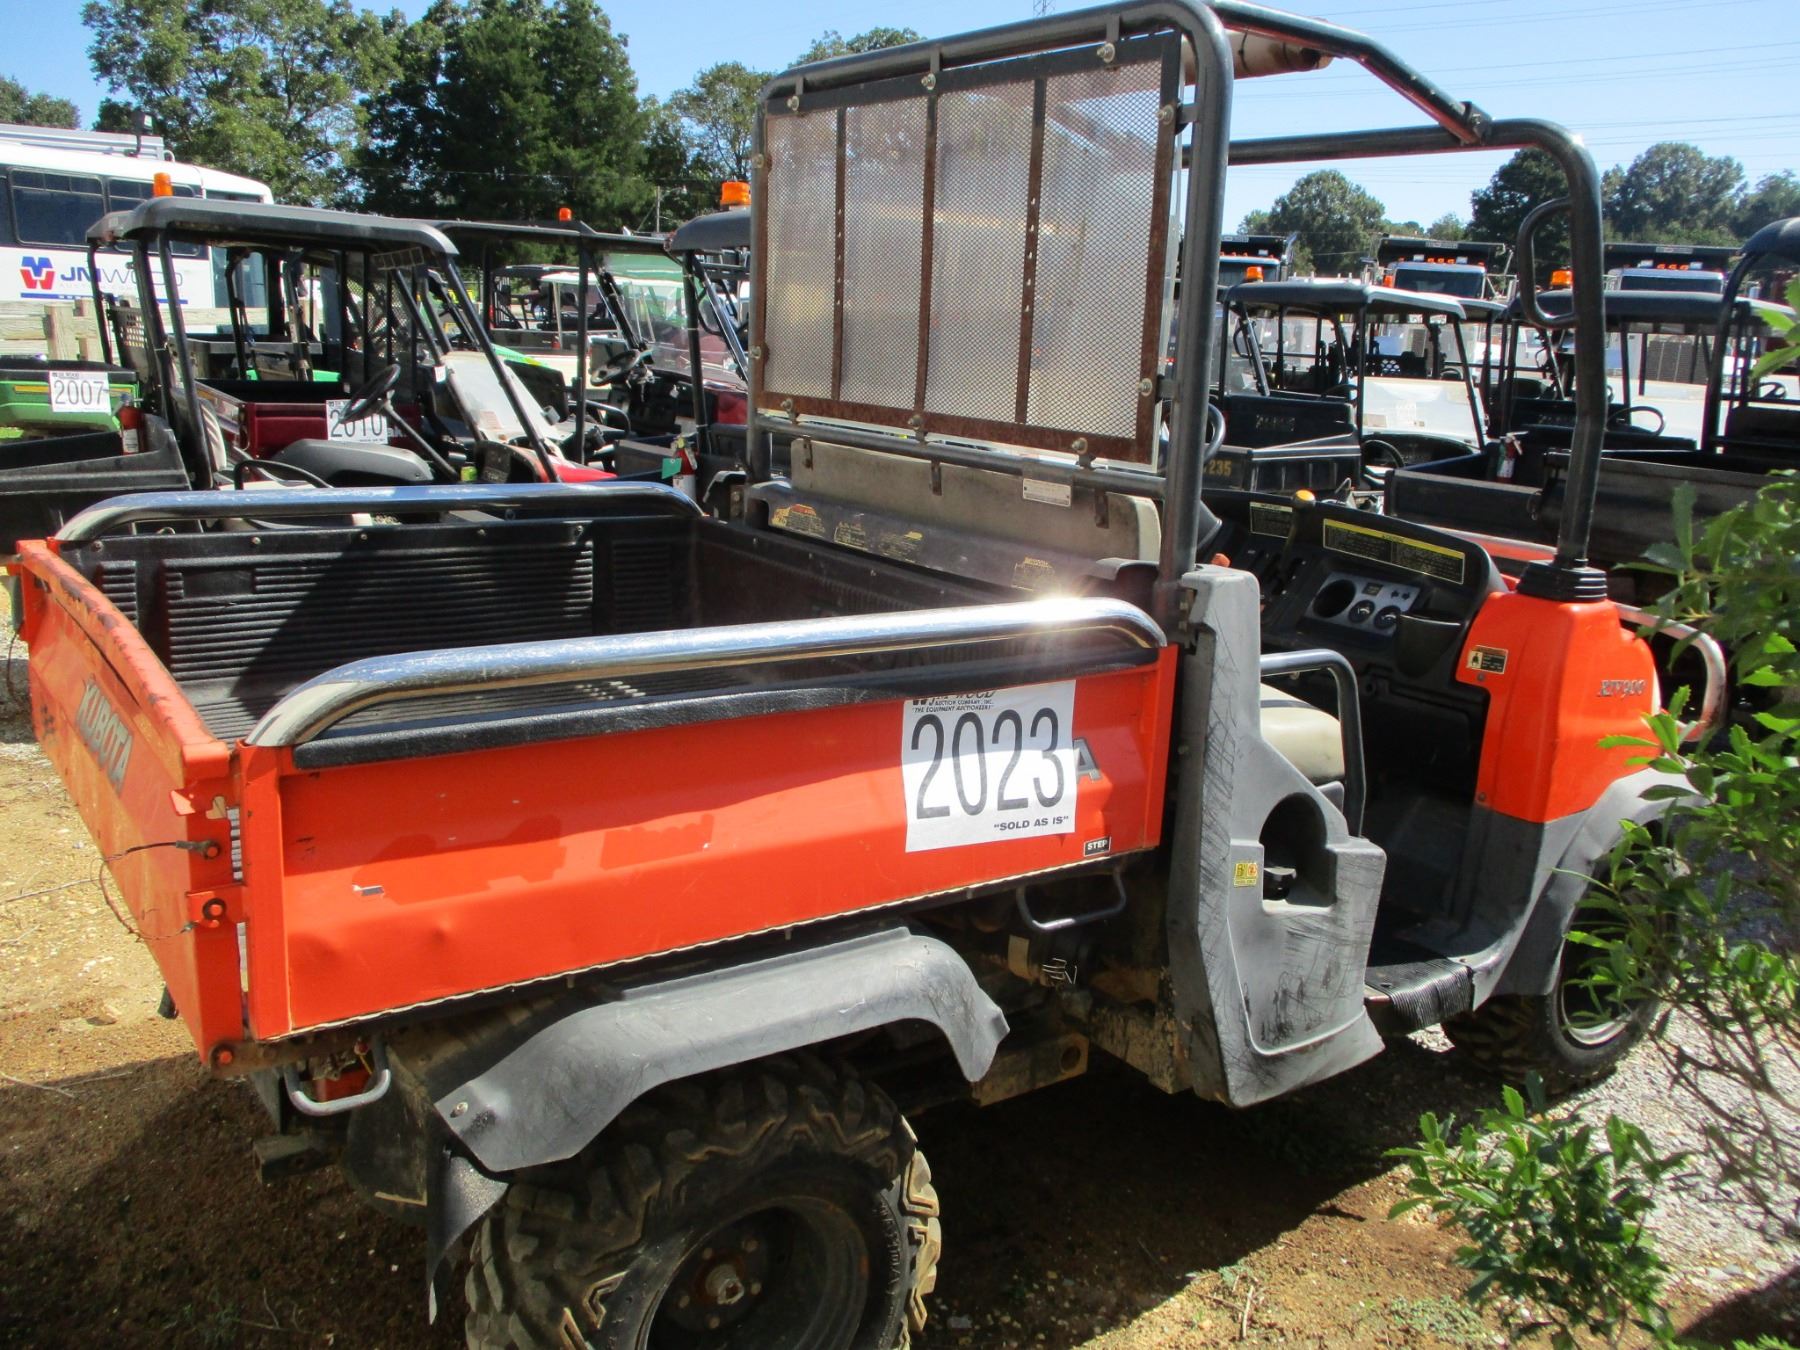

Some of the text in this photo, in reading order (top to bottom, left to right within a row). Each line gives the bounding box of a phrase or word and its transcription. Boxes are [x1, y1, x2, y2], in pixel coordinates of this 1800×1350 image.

[54, 379, 104, 406] 2007
[330, 410, 382, 437] 2010
[77, 682, 133, 794] KUBOTA
[911, 708, 1064, 819] 2023
[994, 815, 1070, 831] "SOLD AS IS"
[1087, 839, 1108, 851] STEP
